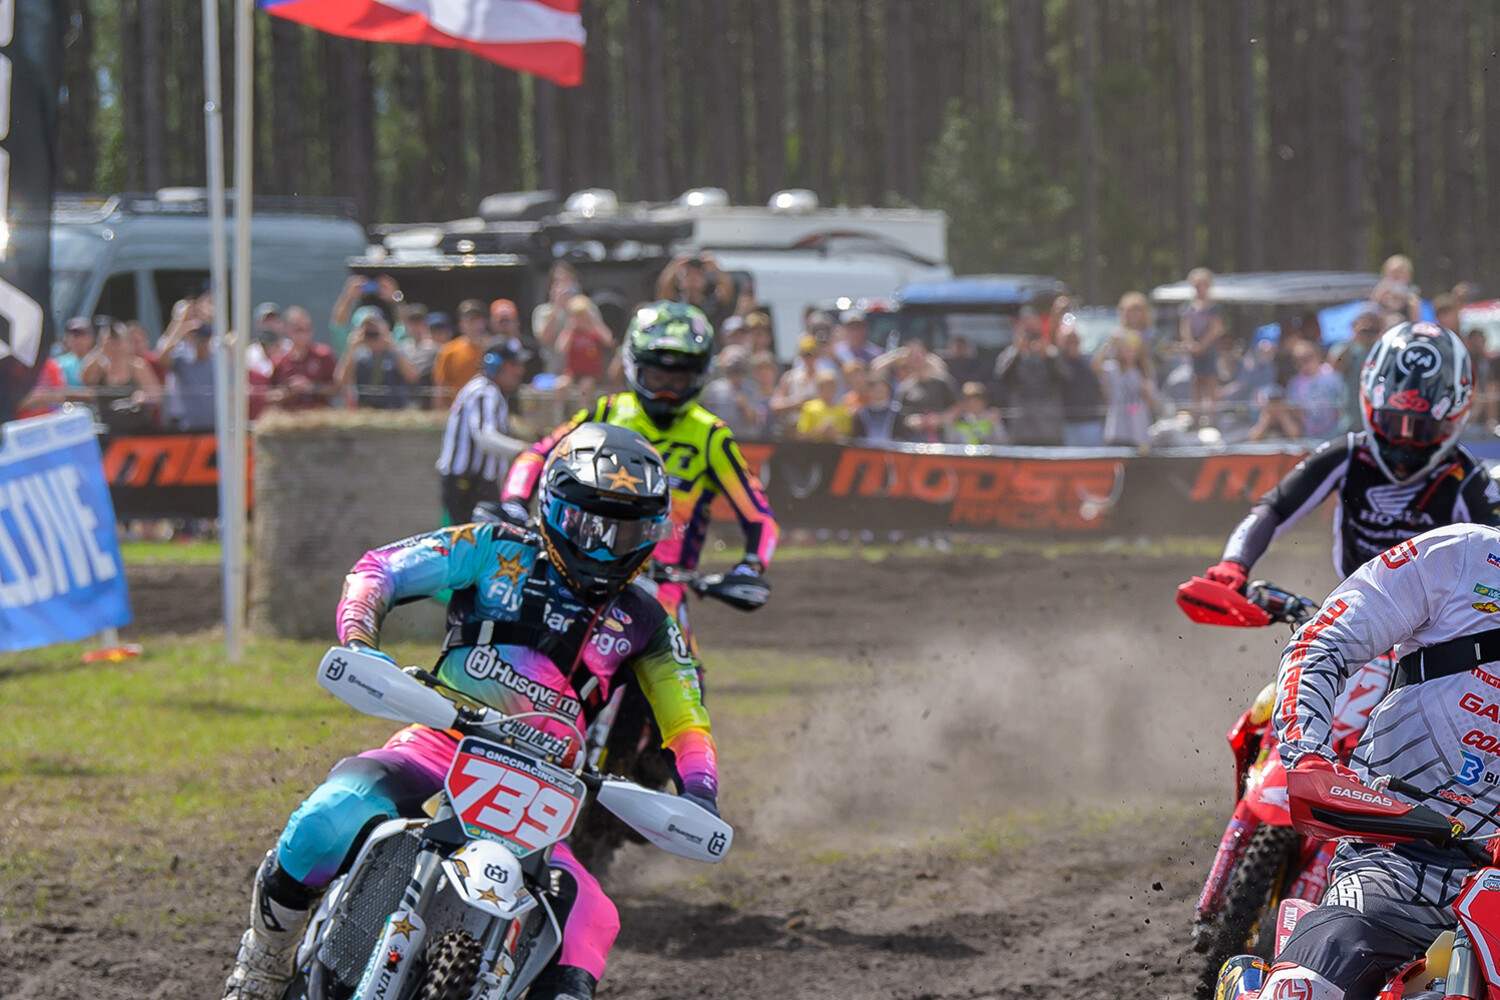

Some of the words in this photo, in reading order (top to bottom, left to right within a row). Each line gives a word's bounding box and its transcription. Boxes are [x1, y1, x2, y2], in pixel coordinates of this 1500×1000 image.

[829, 447, 1128, 502] MOOSE
[488, 580, 525, 613] Fly
[490, 660, 582, 717] Husqvarn
[452, 757, 576, 851] 739
[1329, 785, 1394, 808] GASGAS
